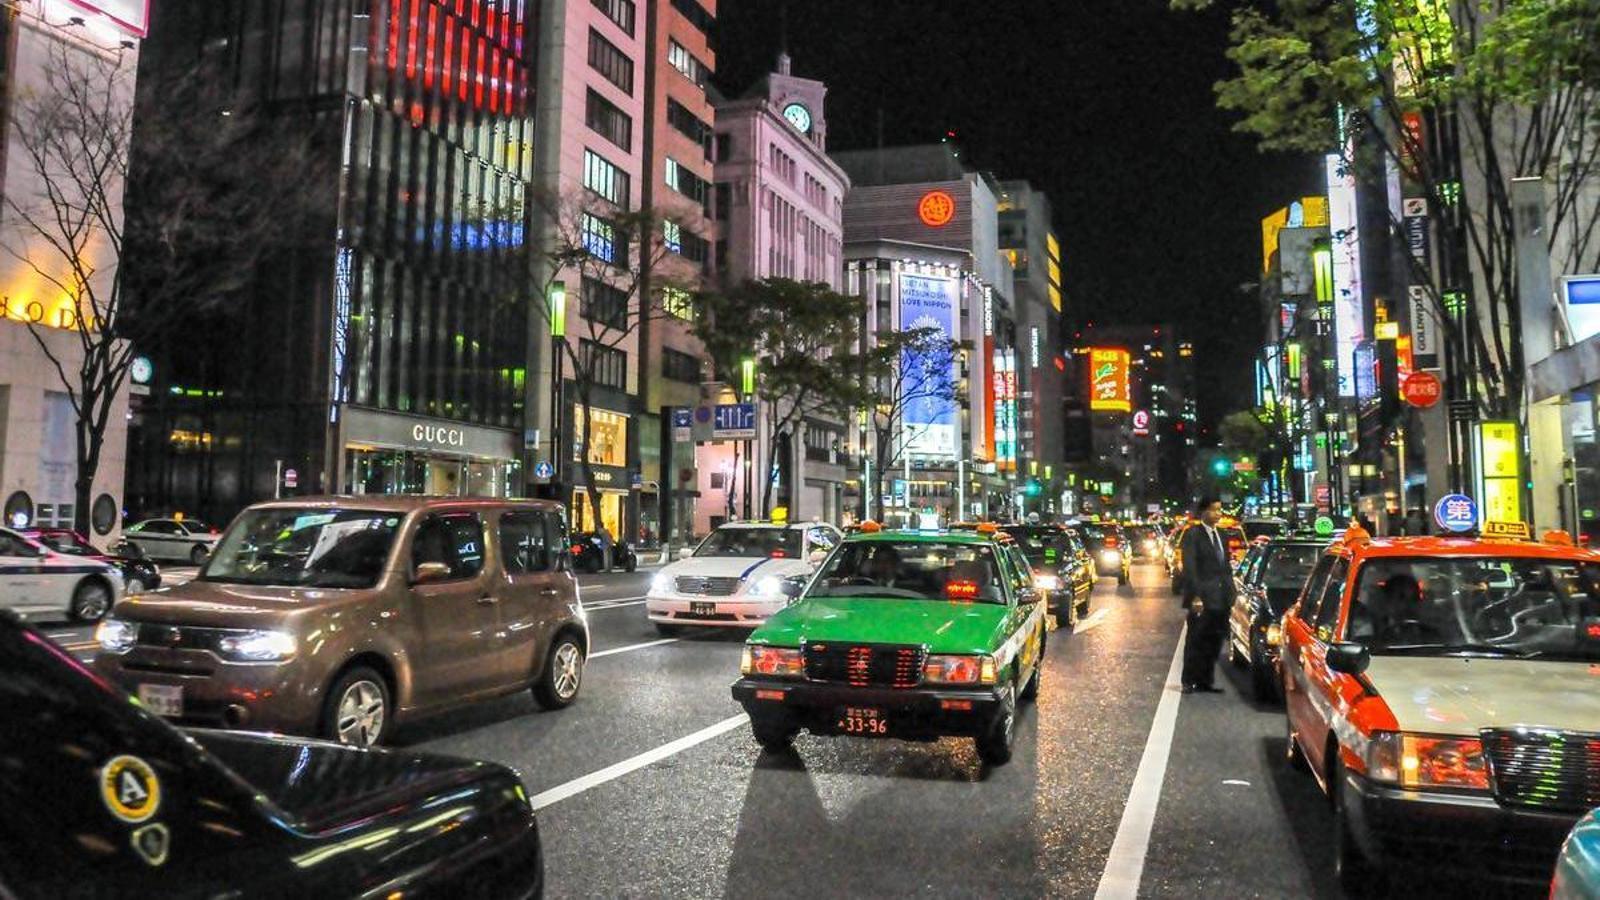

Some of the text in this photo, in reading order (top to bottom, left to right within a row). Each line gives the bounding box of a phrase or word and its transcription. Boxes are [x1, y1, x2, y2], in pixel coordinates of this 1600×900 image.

[902, 297, 952, 310] LOVE NIPPON
[412, 424, 464, 446] GUCCI
[846, 717, 887, 733] 33-96
[120, 769, 148, 804] A
